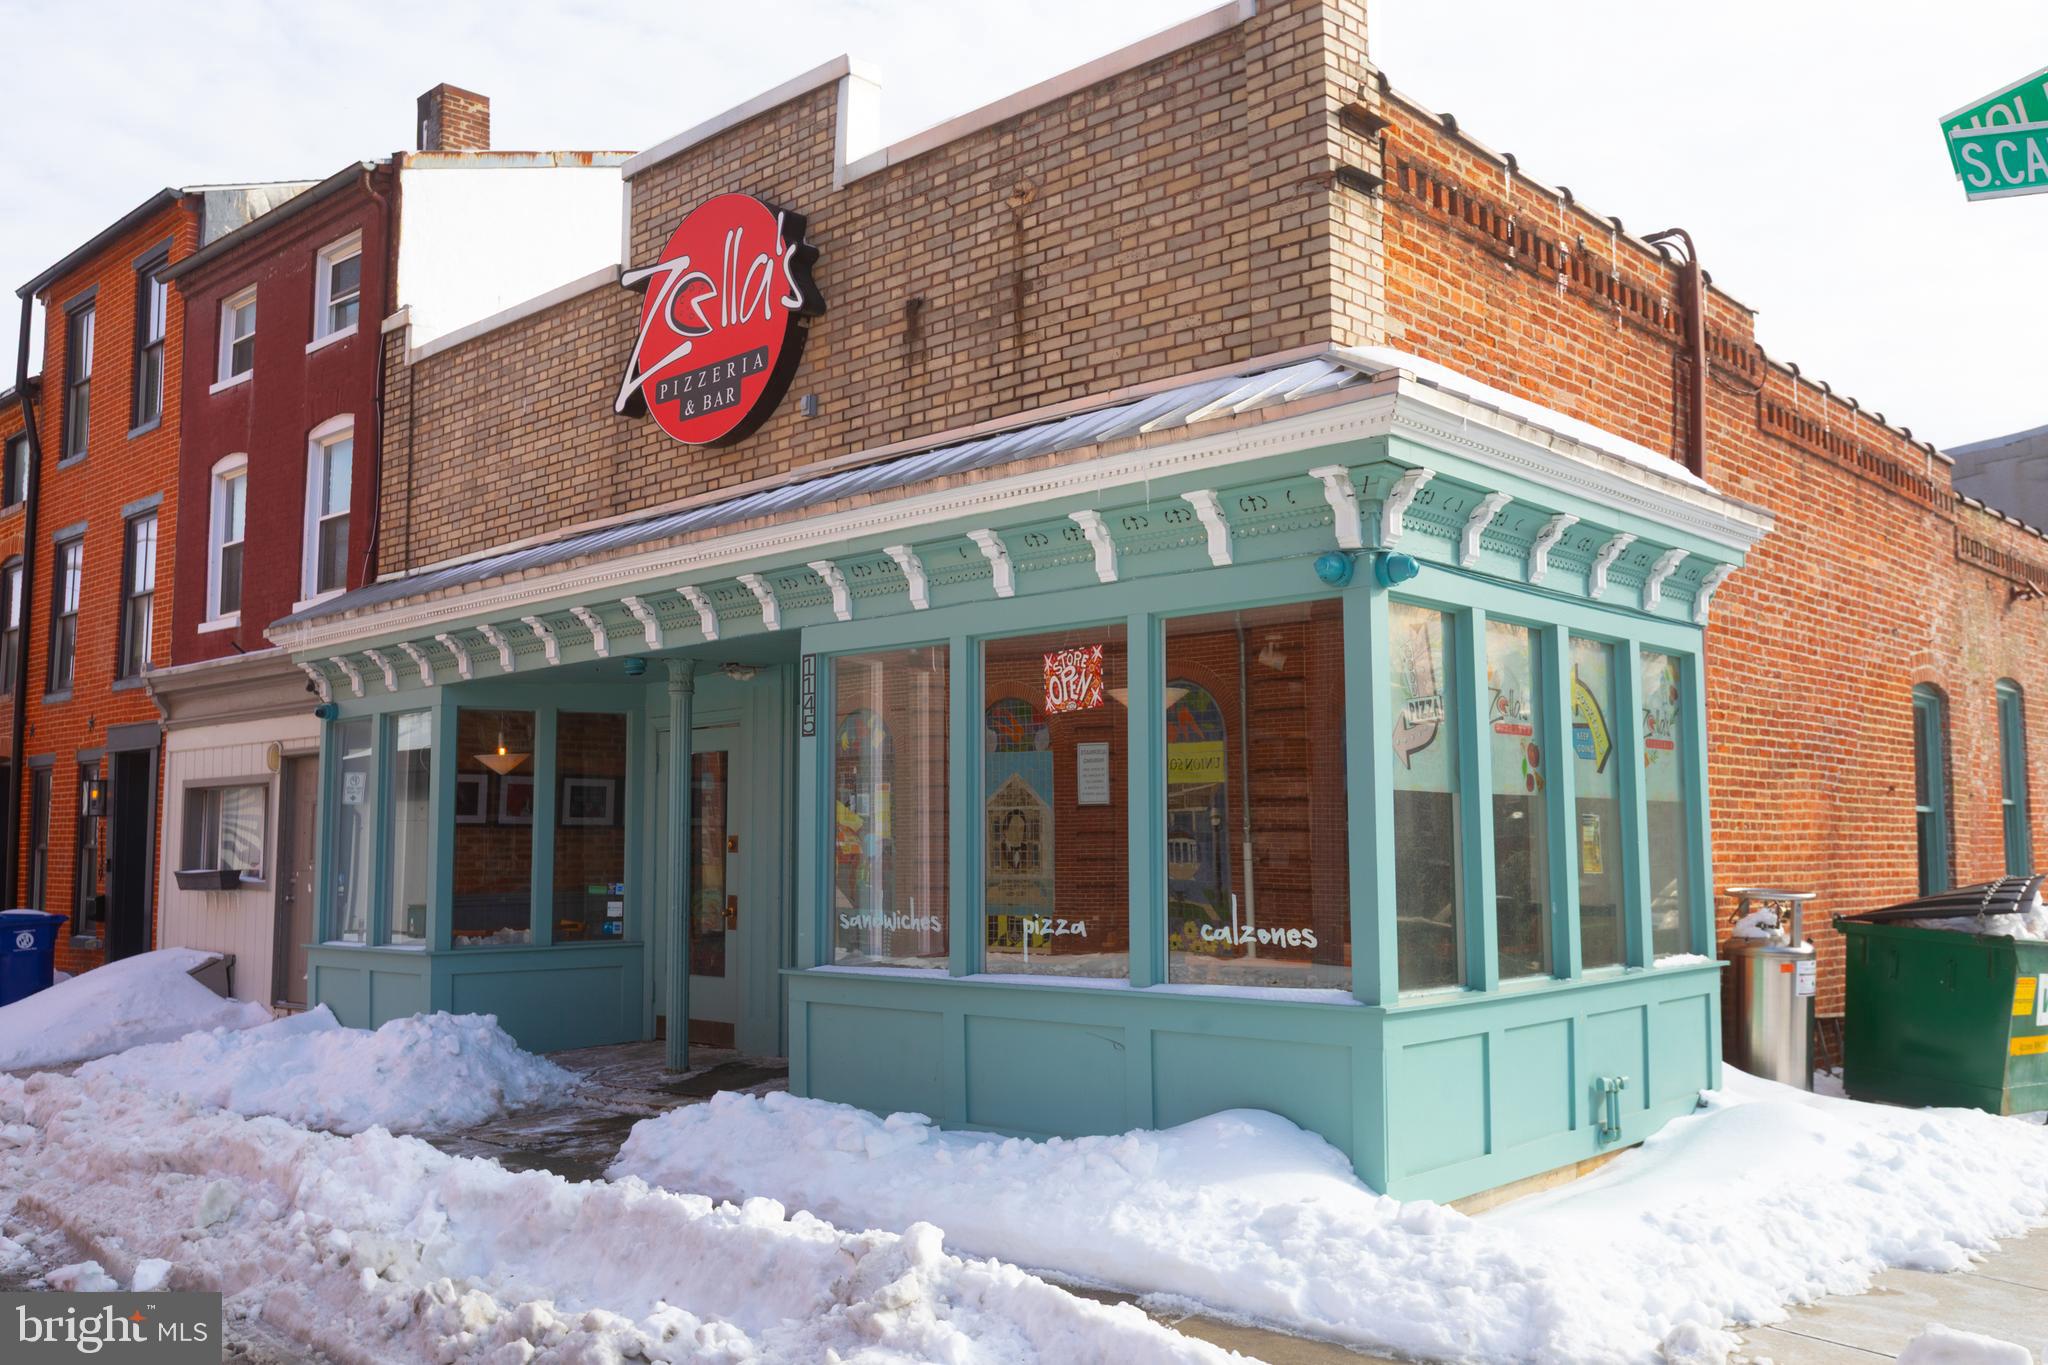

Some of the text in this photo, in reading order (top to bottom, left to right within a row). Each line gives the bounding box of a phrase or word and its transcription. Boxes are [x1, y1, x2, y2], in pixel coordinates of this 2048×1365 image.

[615, 211, 802, 412] Zella's
[660, 352, 764, 400] PIZZERIA
[684, 387, 736, 416] & BAR
[1049, 665, 1093, 704] OPEN
[1053, 651, 1089, 674] STORE
[802, 656, 816, 736] 1145
[839, 890, 942, 933] sandwiches
[1200, 893, 1318, 949] calzones
[1023, 914, 1087, 962] pizza
